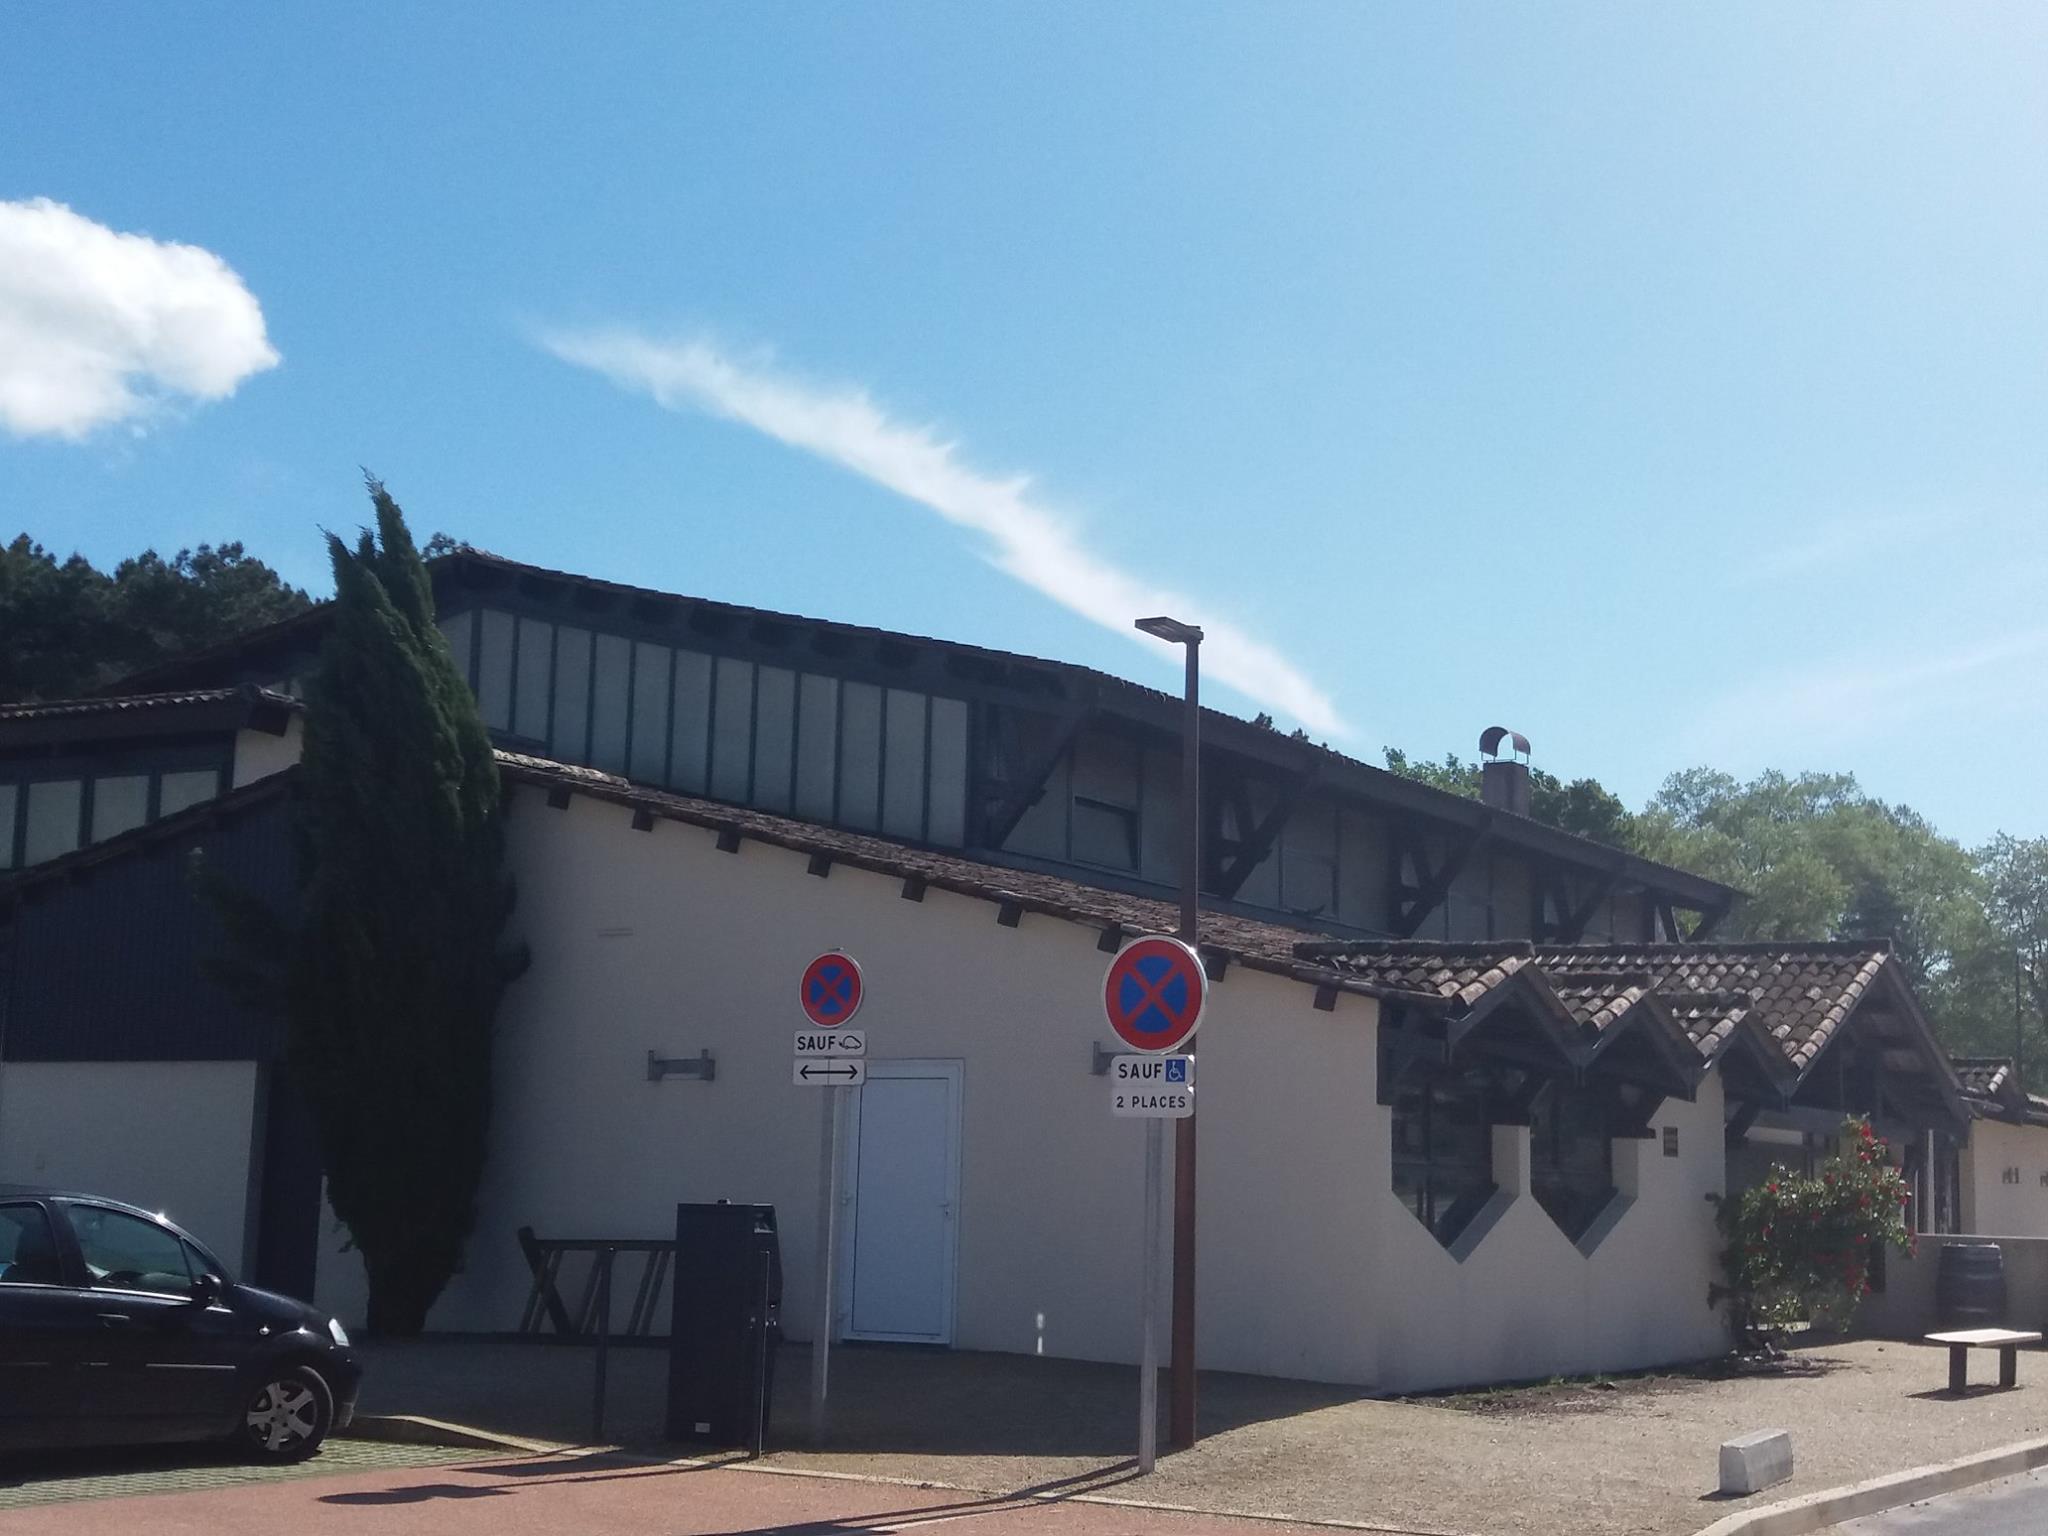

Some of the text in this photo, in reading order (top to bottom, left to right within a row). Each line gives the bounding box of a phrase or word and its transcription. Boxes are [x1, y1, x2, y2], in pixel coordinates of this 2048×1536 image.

[797, 1035, 836, 1050] SAUF
[1118, 1063, 1163, 1079] SAUF
[1116, 1096, 1186, 1108] 2 PLACES
